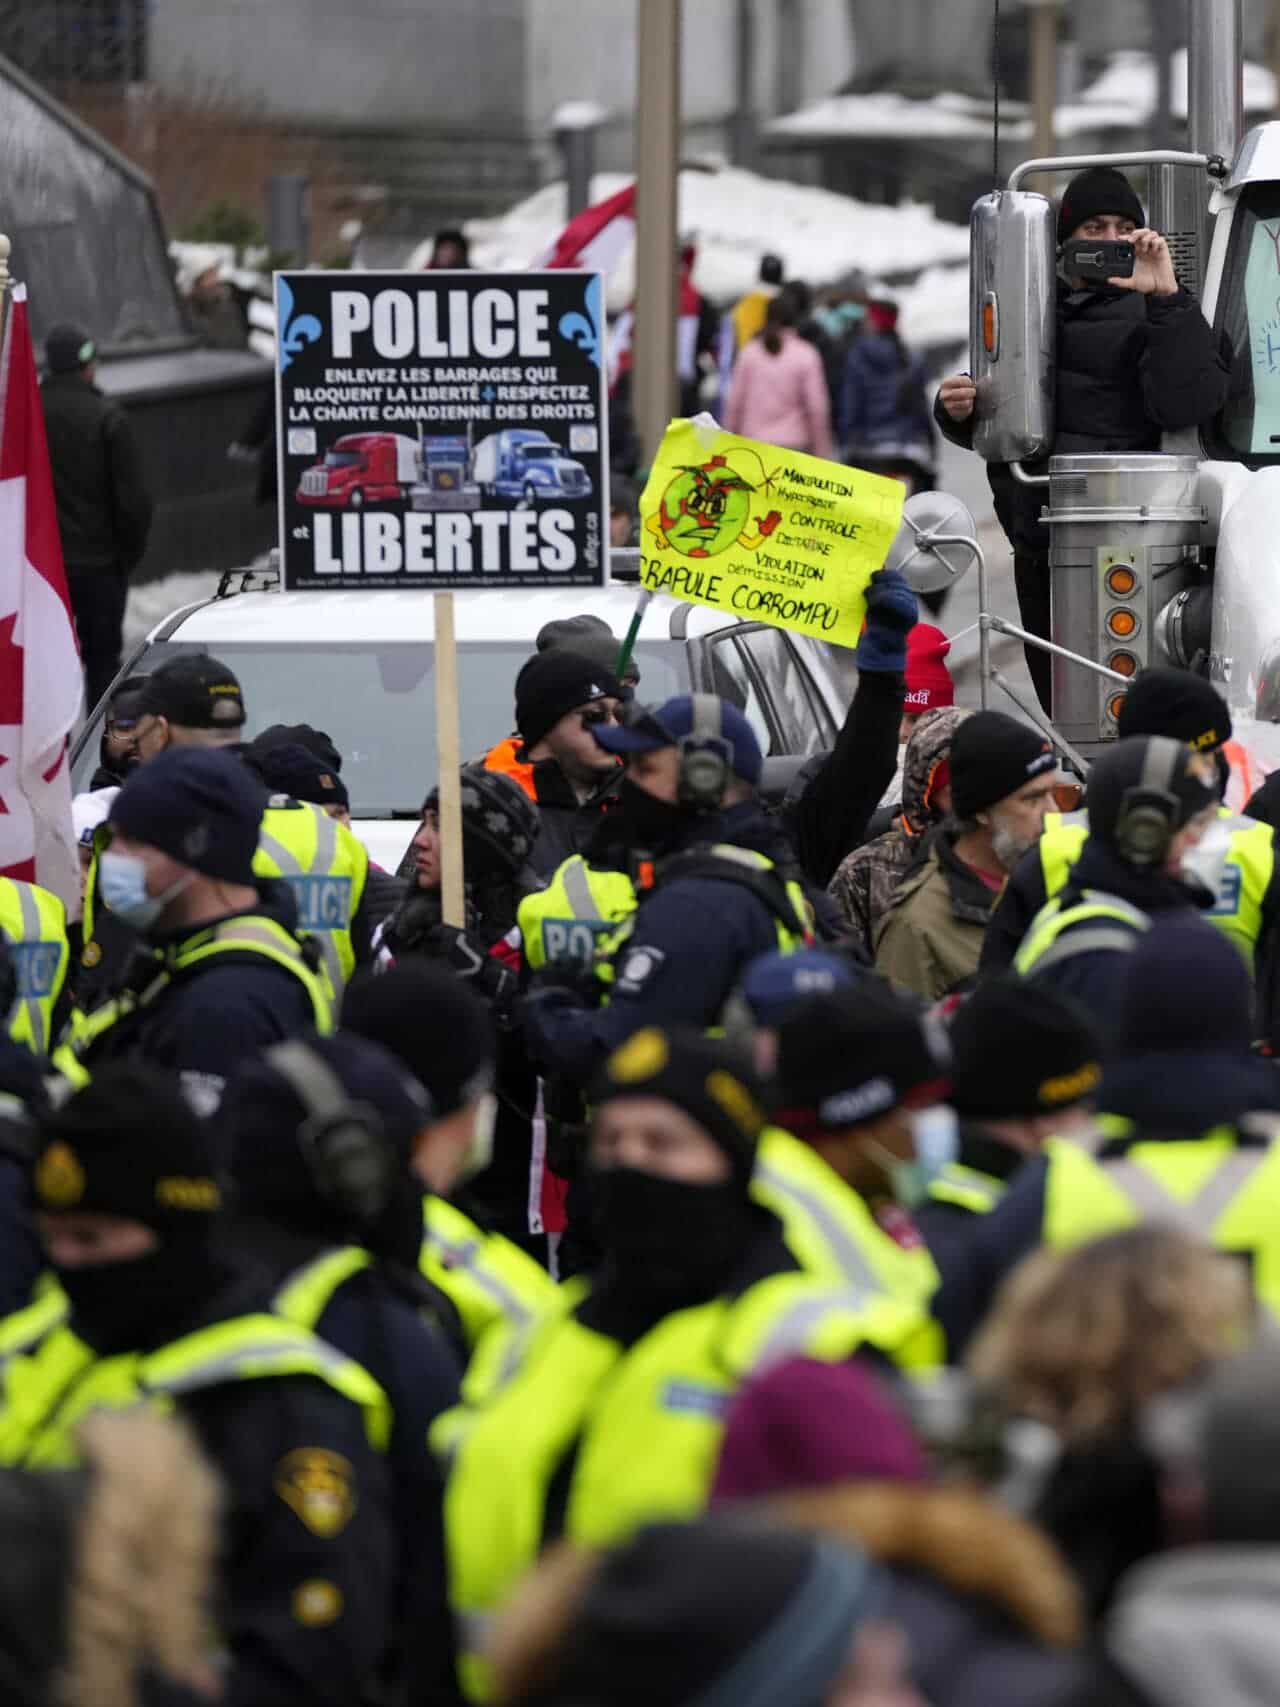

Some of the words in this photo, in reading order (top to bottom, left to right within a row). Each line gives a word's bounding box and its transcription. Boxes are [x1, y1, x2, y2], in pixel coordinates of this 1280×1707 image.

[330, 289, 551, 359] POLICE
[324, 368, 398, 383] ENLEVEZ
[400, 367, 431, 383] LES
[433, 367, 523, 383] BARRAGES
[524, 366, 558, 384] QUI
[293, 386, 383, 404] BLOQUENT
[386, 386, 408, 401] LA
[410, 382, 480, 401] LIBERTÉ
[497, 384, 590, 401] RESPECTEZ
[289, 406, 311, 421] LA
[313, 405, 379, 421] CHARTE
[382, 404, 492, 421] CANADIENNE
[495, 404, 528, 420] DES
[530, 403, 595, 420] DROITS
[292, 525, 310, 539] et
[313, 502, 576, 573] LIBERTÉS
